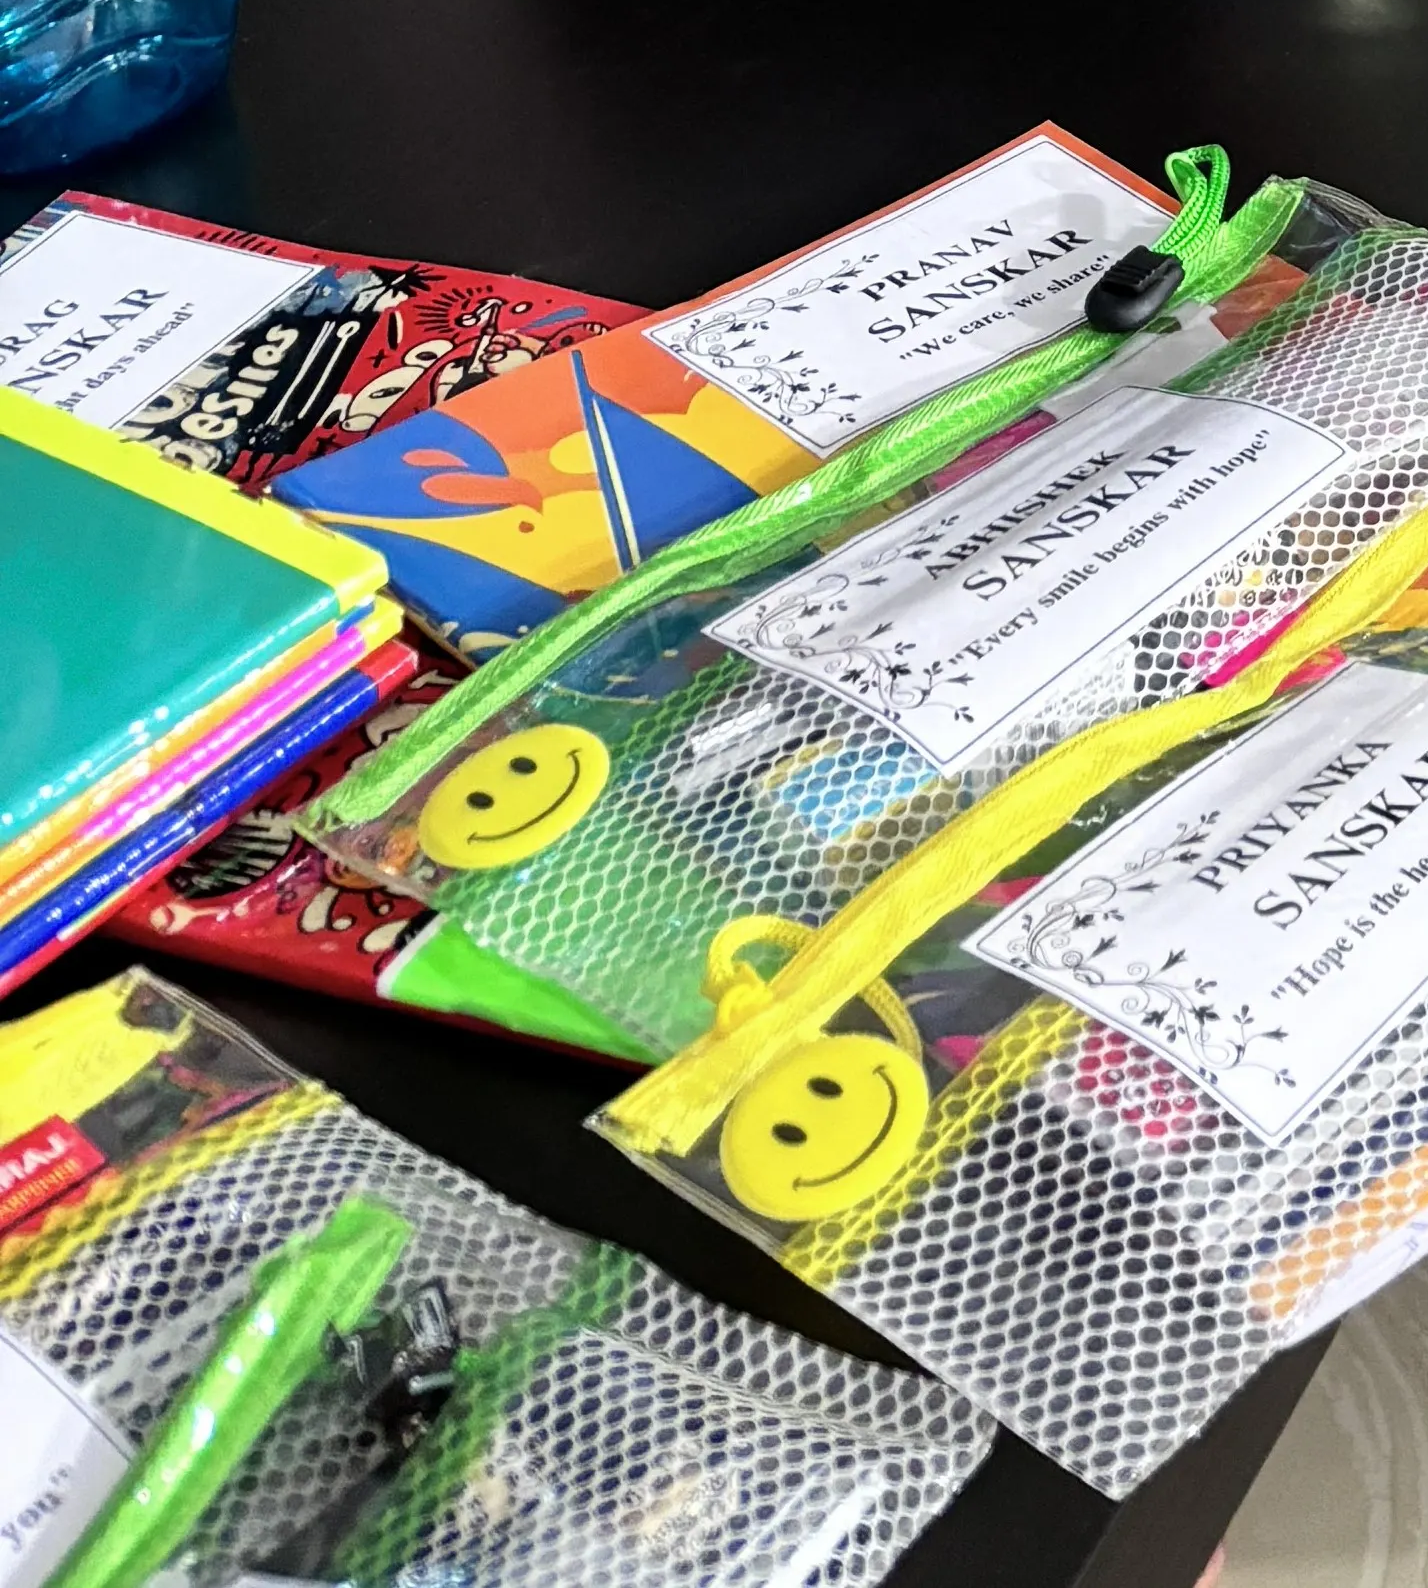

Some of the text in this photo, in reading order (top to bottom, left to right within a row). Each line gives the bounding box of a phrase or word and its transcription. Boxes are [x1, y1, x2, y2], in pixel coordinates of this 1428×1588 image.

[858, 219, 1014, 303] PRANAV
[868, 230, 1094, 344] SANSKAR
[899, 254, 1110, 360] "We care, we share"
[0, 299, 79, 366] RAG
[7, 289, 170, 397] NSKAR
[82, 355, 135, 390] days
[923, 450, 1127, 581] ABHISHEK
[948, 430, 1271, 669] "Every smile begins with hope"
[962, 442, 1195, 602] SANSKAR
[1190, 738, 1393, 894] PRIYANKA
[1269, 934, 1352, 1002] "Hope
[1348, 911, 1375, 942] is
[1369, 877, 1410, 916] the
